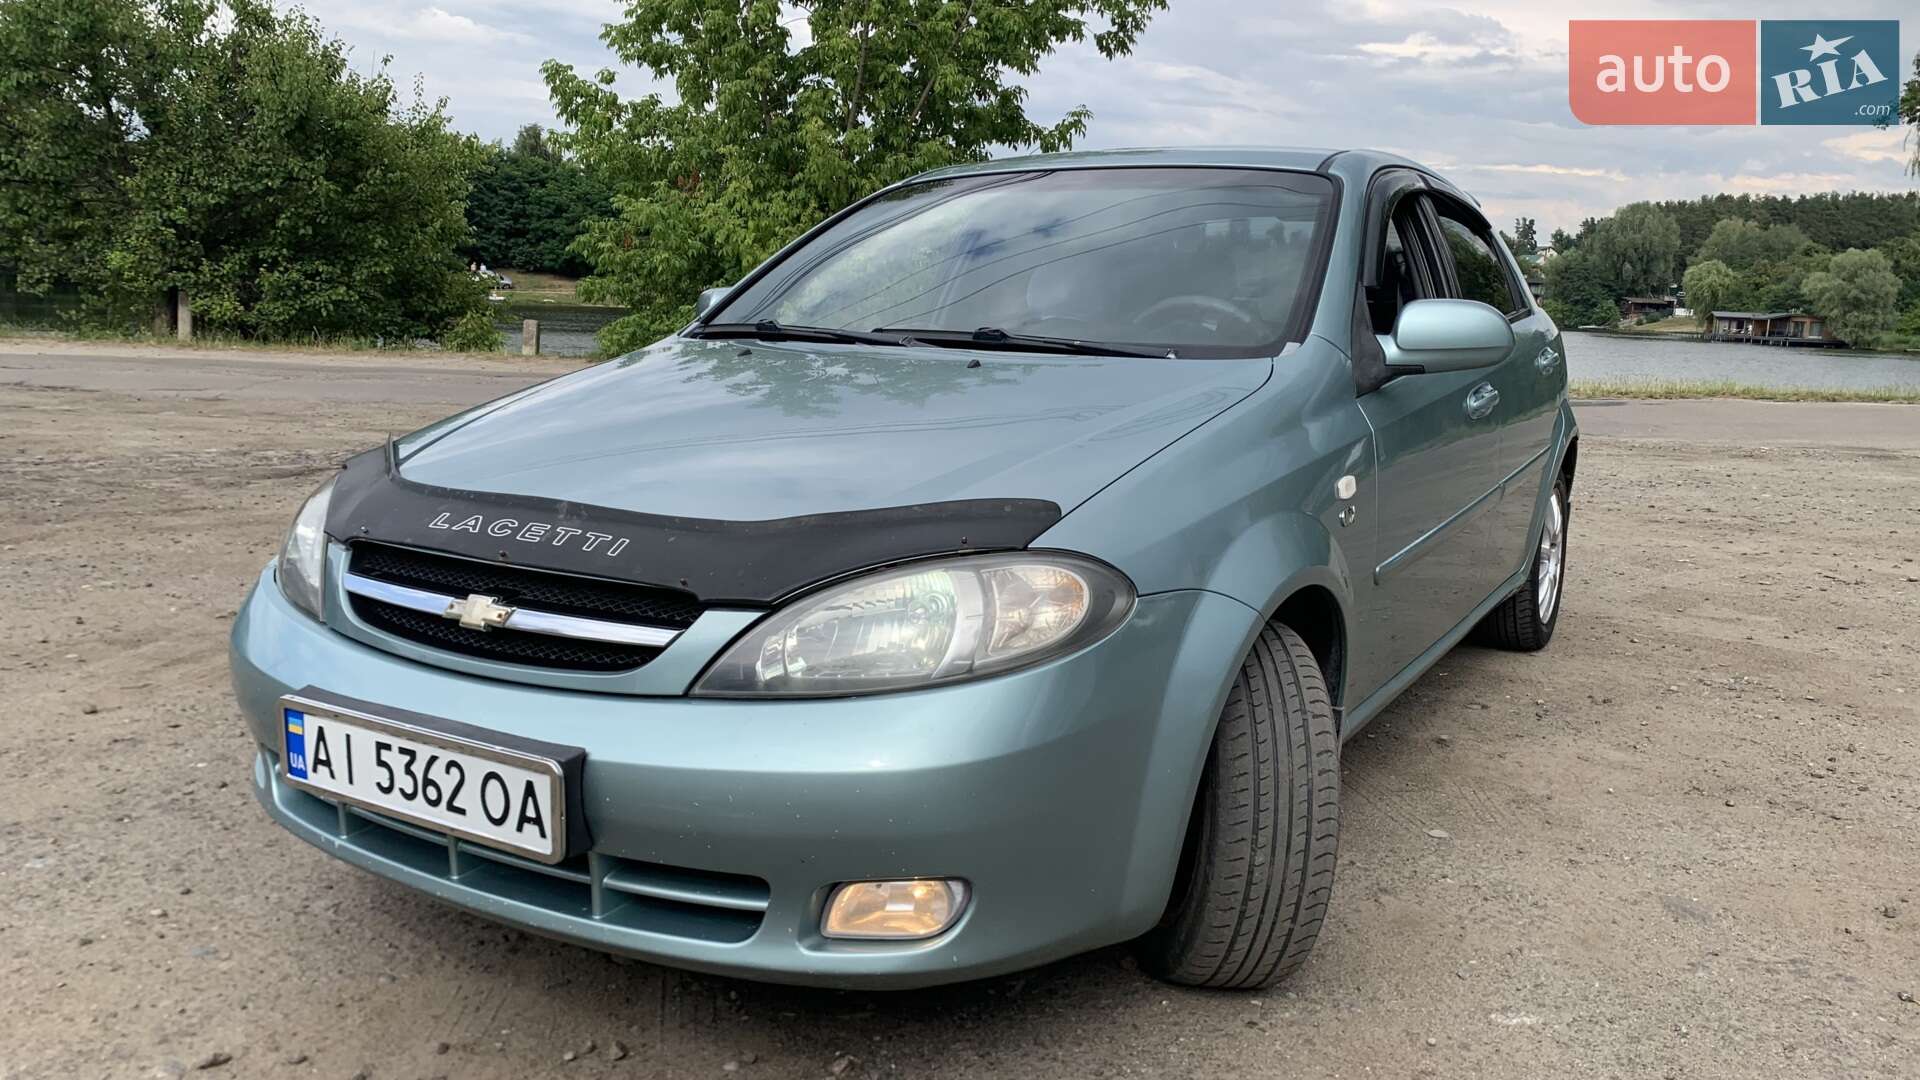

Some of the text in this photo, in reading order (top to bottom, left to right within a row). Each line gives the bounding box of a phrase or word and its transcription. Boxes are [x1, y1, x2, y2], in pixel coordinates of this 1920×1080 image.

[428, 512, 630, 557] LACETTI
[290, 754, 306, 772] UA
[312, 725, 547, 839] AI 5362 OA
